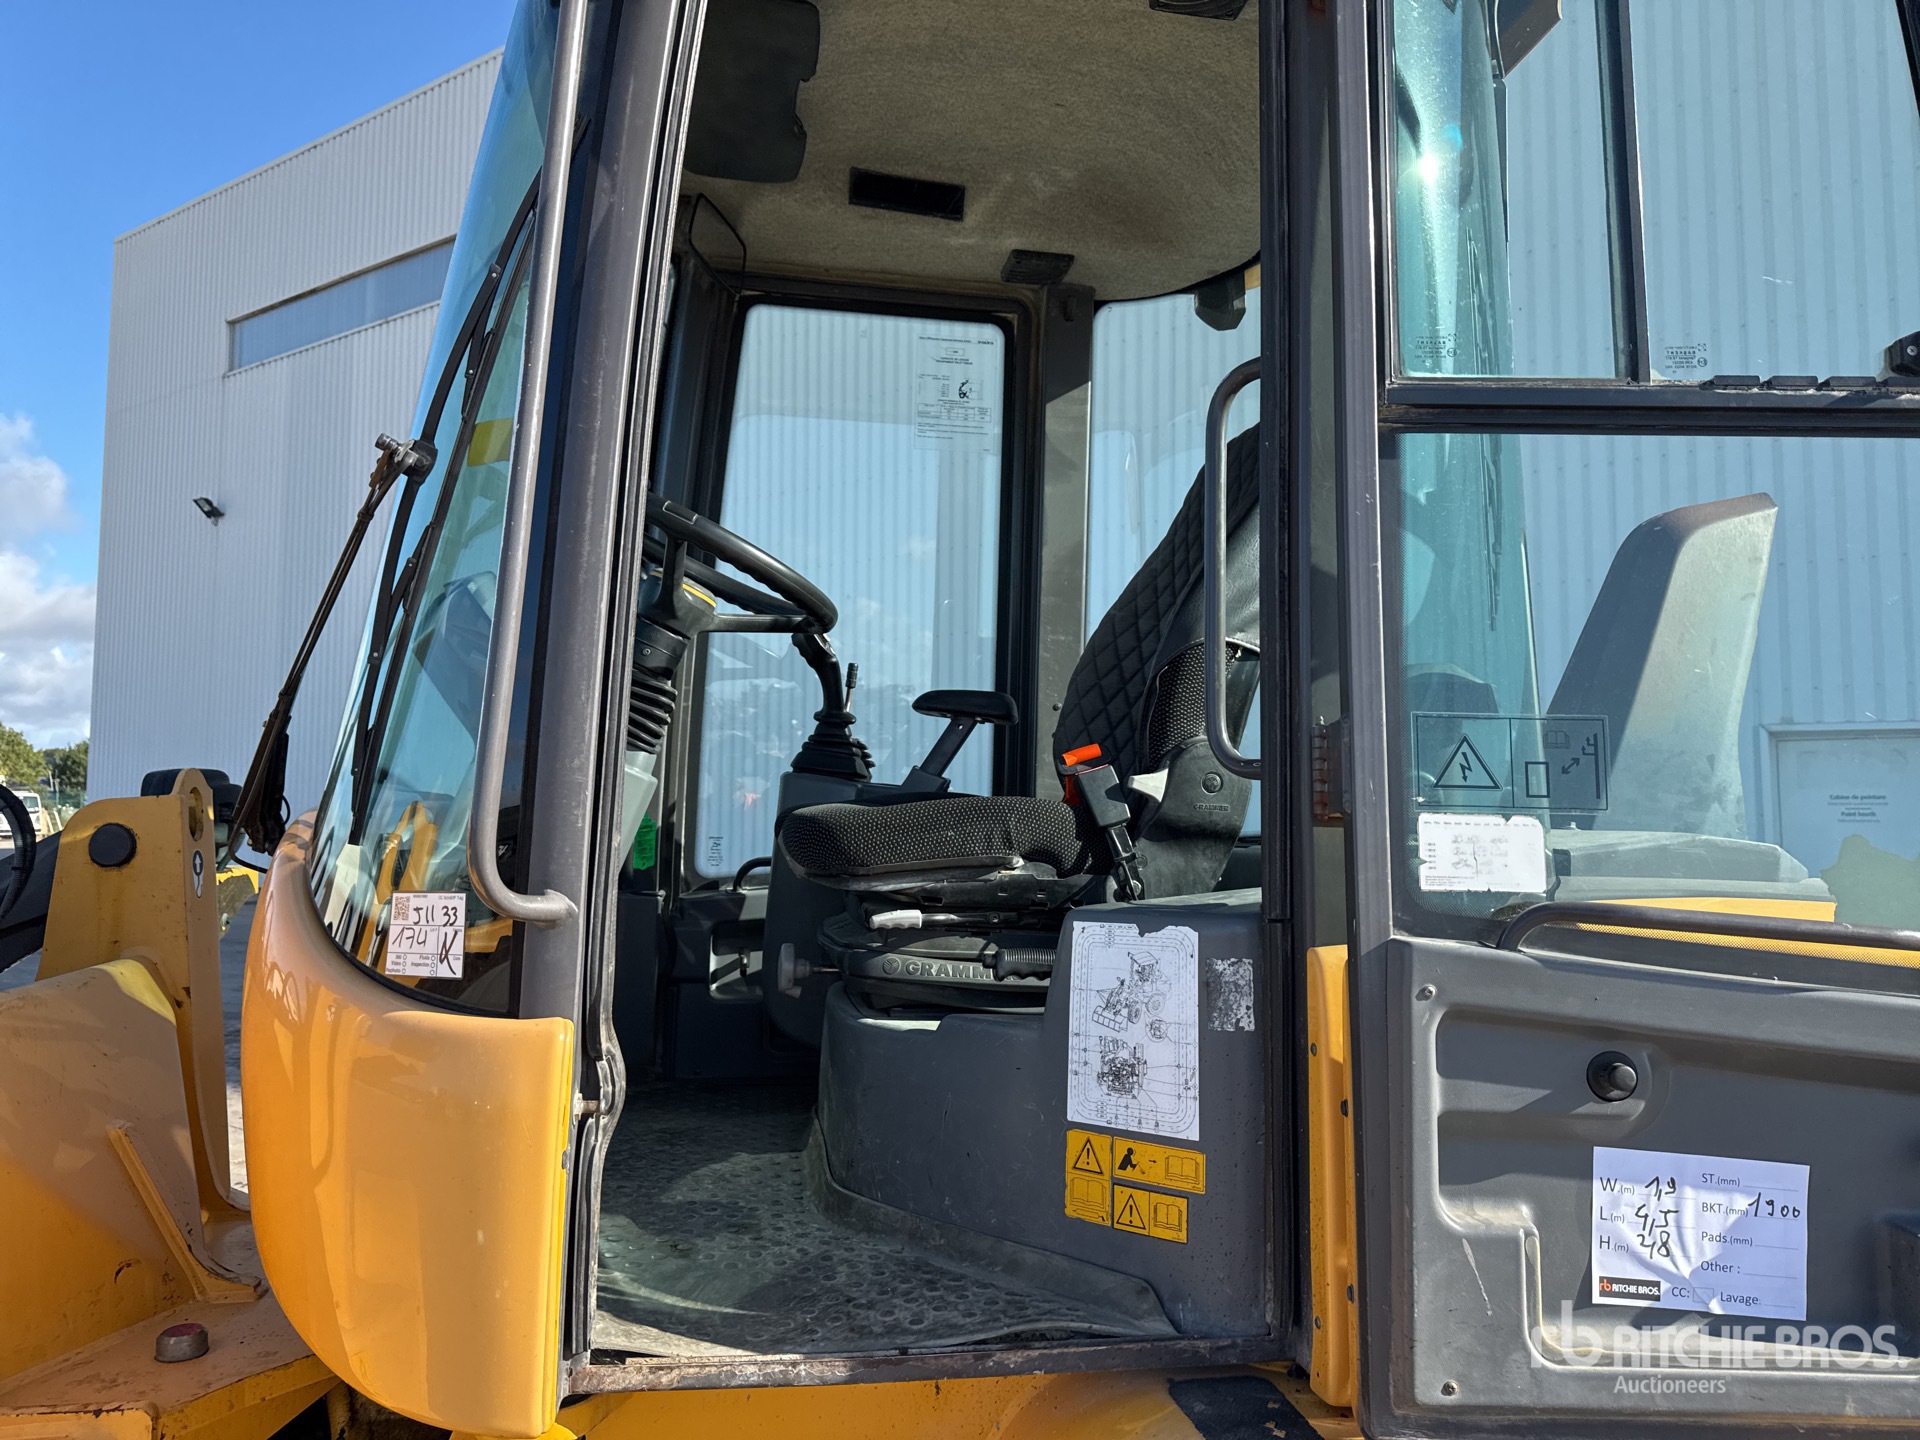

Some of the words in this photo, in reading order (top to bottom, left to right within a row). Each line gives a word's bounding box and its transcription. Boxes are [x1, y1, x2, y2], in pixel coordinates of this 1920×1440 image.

[1193, 803, 1231, 812] GRAMMER
[905, 960, 1022, 981] GRAMM
[1748, 1191, 1801, 1219] 1900
[1700, 1260, 1734, 1273] Other
[1612, 1284, 1638, 1295] RITCHIE
[1638, 1285, 1660, 1296] BROS.
[1671, 1286, 1690, 1299] CC:
